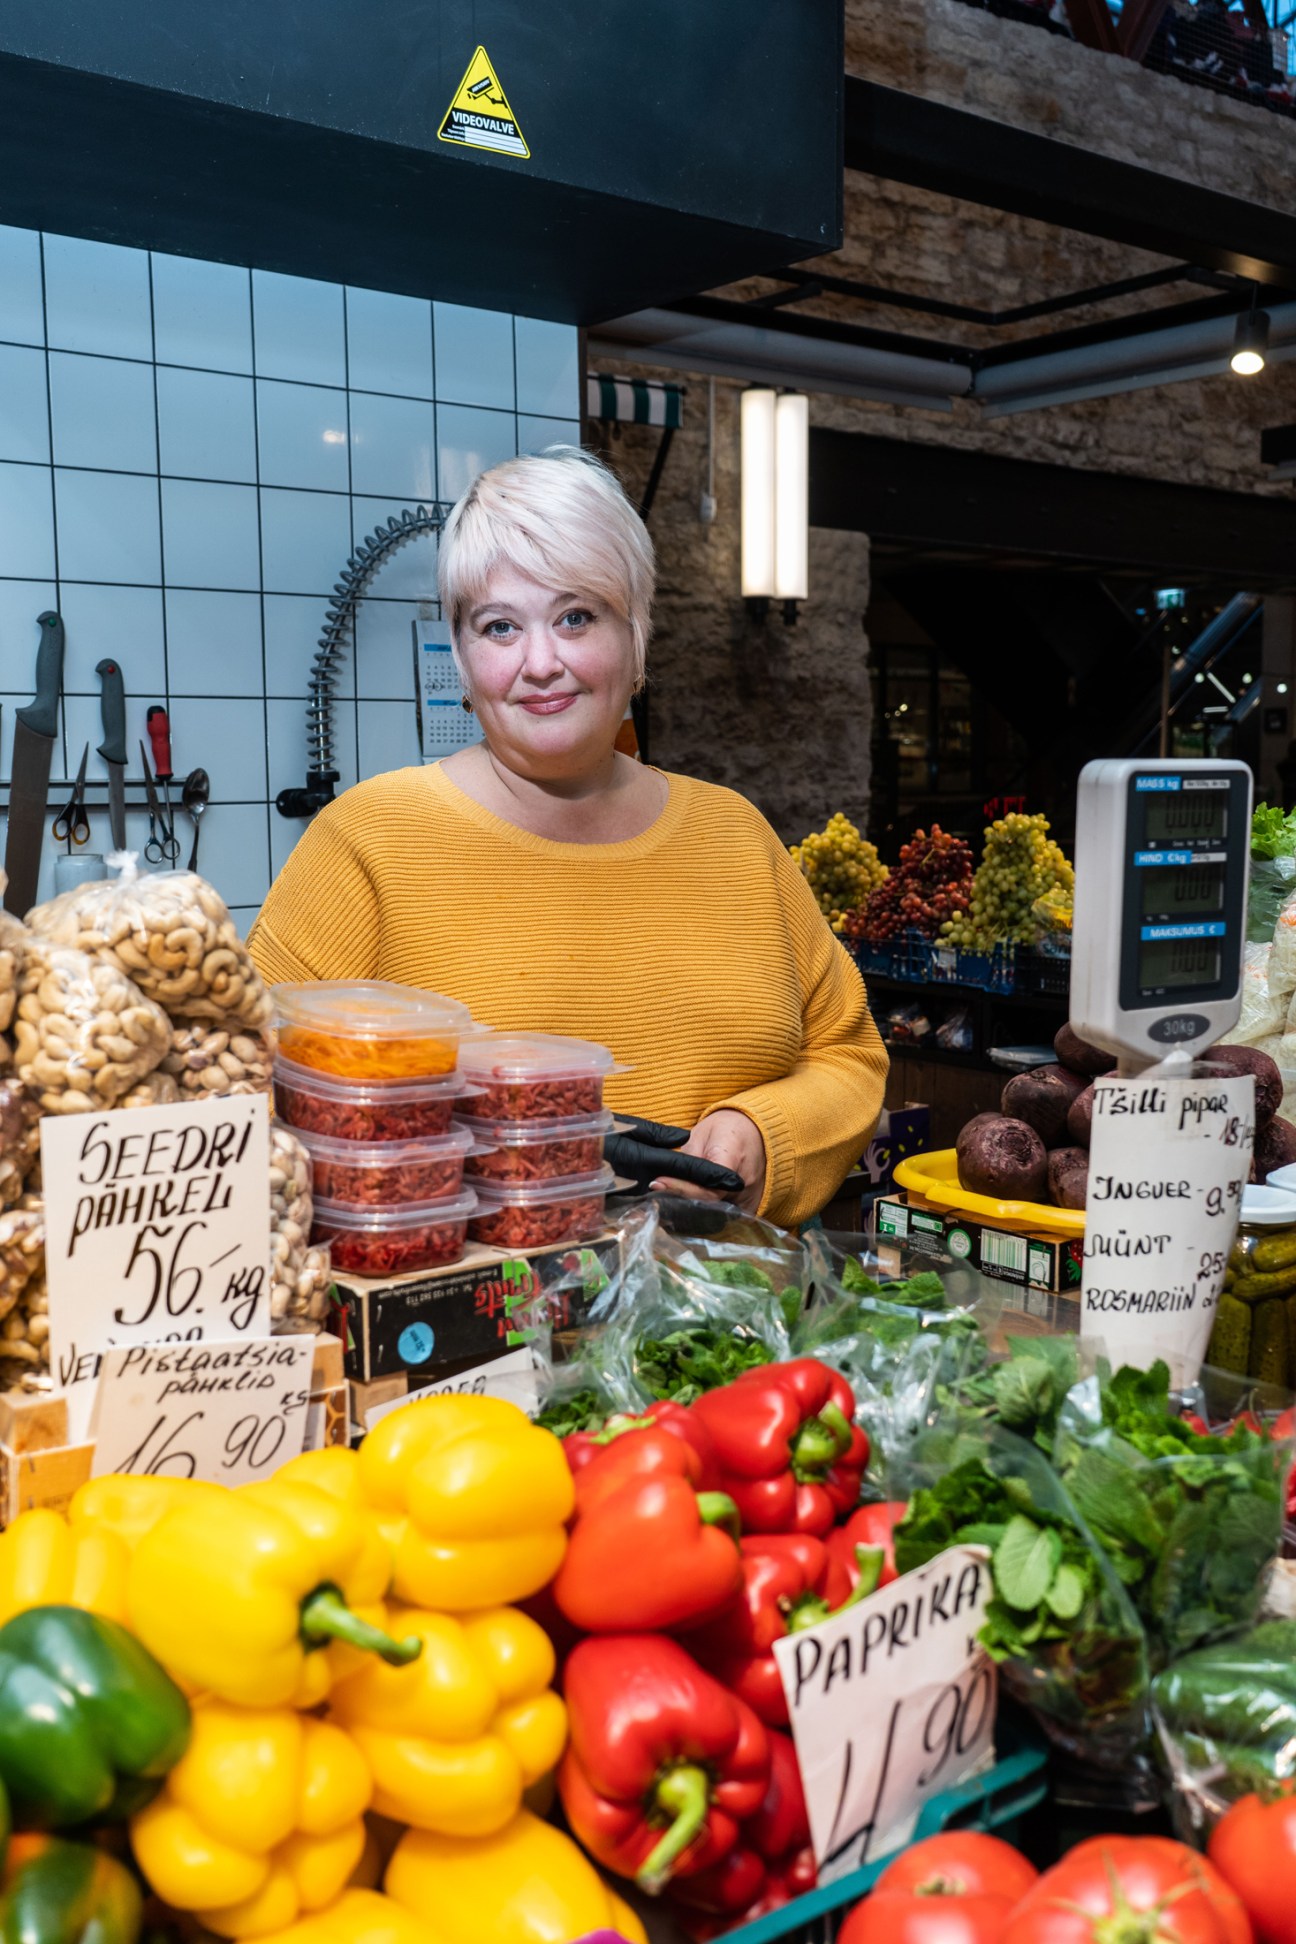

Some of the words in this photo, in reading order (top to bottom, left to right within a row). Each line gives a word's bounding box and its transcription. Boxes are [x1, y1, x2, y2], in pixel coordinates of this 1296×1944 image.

[452, 111, 515, 135] VIDEOVALVE
[1136, 778, 1164, 789] MASS
[1166, 778, 1179, 790] kg
[1138, 853, 1162, 864] HIND
[1150, 926, 1205, 938] MAKSUMUS
[1163, 1018, 1196, 1038] 30kg
[79, 1108, 256, 1185] SEEDRI
[221, 1265, 266, 1331] kg
[1086, 1283, 1196, 1313] ROSMARIIN
[794, 1563, 982, 1707] PAPRIKA
[918, 1667, 991, 1787] 90
